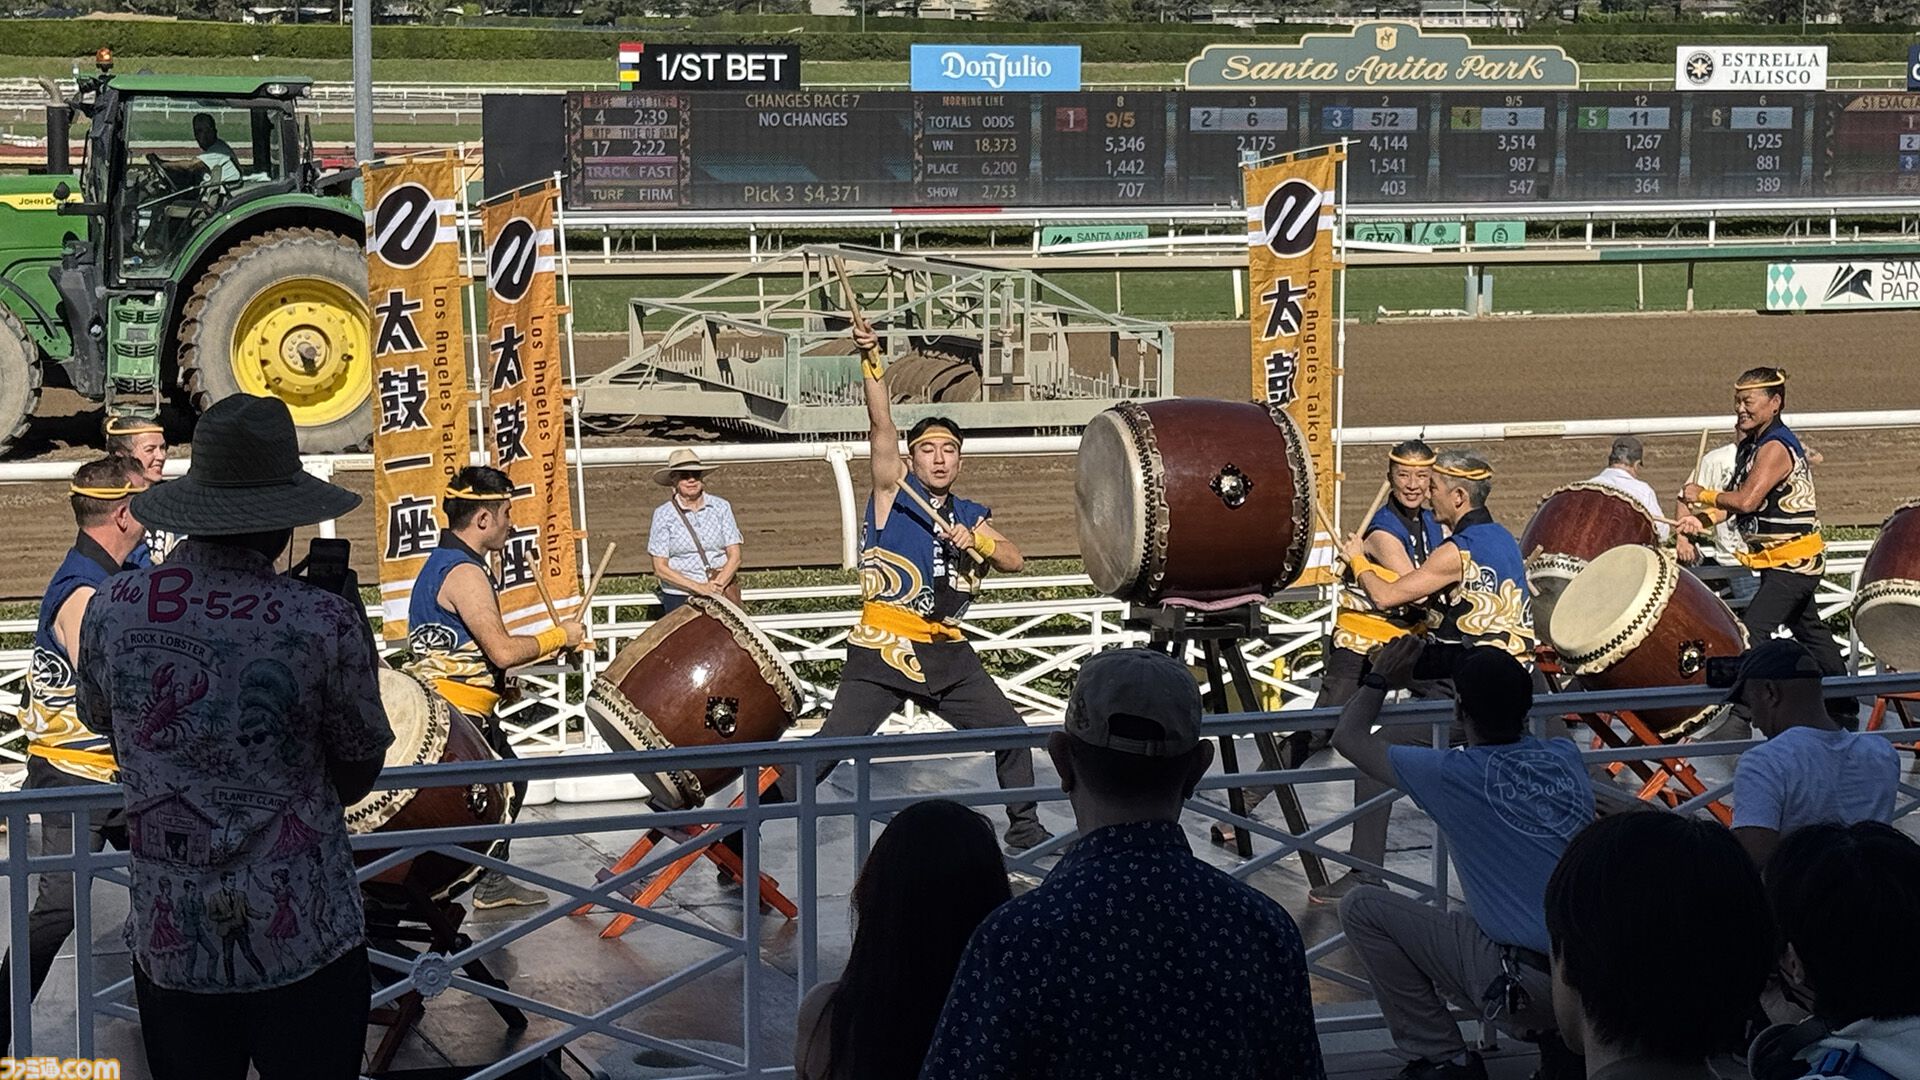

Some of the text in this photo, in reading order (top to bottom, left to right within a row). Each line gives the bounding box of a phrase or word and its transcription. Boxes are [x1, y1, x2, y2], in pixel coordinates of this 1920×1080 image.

[655, 53, 788, 82] 1/ST BET
[1722, 53, 1820, 67] ESTRELLA
[1221, 55, 1547, 84] Santa Anita Park
[1730, 70, 1811, 84] JALISCO
[745, 94, 860, 108] CHANGES RACE 7
[1117, 96, 1124, 107] 8
[1250, 96, 1256, 107] 3
[1382, 96, 1389, 107] 2
[1505, 96, 1523, 106] 9/5
[1634, 96, 1648, 106] 12
[1759, 96, 1767, 106] 6
[594, 110, 668, 125] 4 2:39
[759, 112, 848, 126] NO CHANGES
[929, 116, 1015, 129] TOTALS ODDS
[1067, 110, 1136, 129] 1 9/5
[1201, 111, 1258, 127] 2 6
[1332, 111, 1399, 127] 3 5/2
[1461, 110, 1518, 127] 4 3
[1588, 110, 1649, 127] 5 11
[1712, 109, 1767, 127] 6 6
[591, 141, 666, 156] 17 2:22
[932, 138, 1017, 153] WIN 18,373
[1105, 137, 1145, 153] 5,346
[1237, 136, 1276, 152] 2,175
[1369, 136, 1408, 152] 4,144
[1498, 135, 1536, 151] 3,514
[1625, 135, 1662, 151] 1,267
[1746, 134, 1783, 150] 1,925
[1906, 137, 1914, 148] 2
[927, 161, 1017, 176] PLACE 6,200
[1105, 160, 1145, 176] 1,442
[1370, 158, 1406, 174] 1,541
[1509, 157, 1535, 172] 987
[1635, 157, 1661, 171] 434
[1756, 156, 1780, 170] 881
[1905, 155, 1913, 169] 3
[586, 166, 673, 178] TRACK FAST
[927, 184, 1017, 199] SHOW 2,753
[1118, 183, 1145, 198] 707
[1381, 180, 1407, 195] 403
[1509, 180, 1535, 194] 547
[1634, 179, 1660, 193] 364
[1756, 177, 1781, 192] 389
[591, 189, 673, 200] TURF FIRM
[744, 184, 860, 204] Pick 3 $4,371
[1077, 231, 1144, 242] SANTA ANITA
[1307, 269, 1320, 301] Los
[1303, 310, 1320, 385] Angeles
[433, 286, 457, 478] Los Angeles Taiko
[375, 289, 441, 561] 太鼓一座
[1307, 392, 1321, 443] Taiko
[531, 316, 561, 578] Los Angeles Taiko Ichiza
[110, 567, 284, 624] the B-52's
[130, 632, 206, 658] ROCK LOBSTER
[218, 790, 254, 803] PLANET
